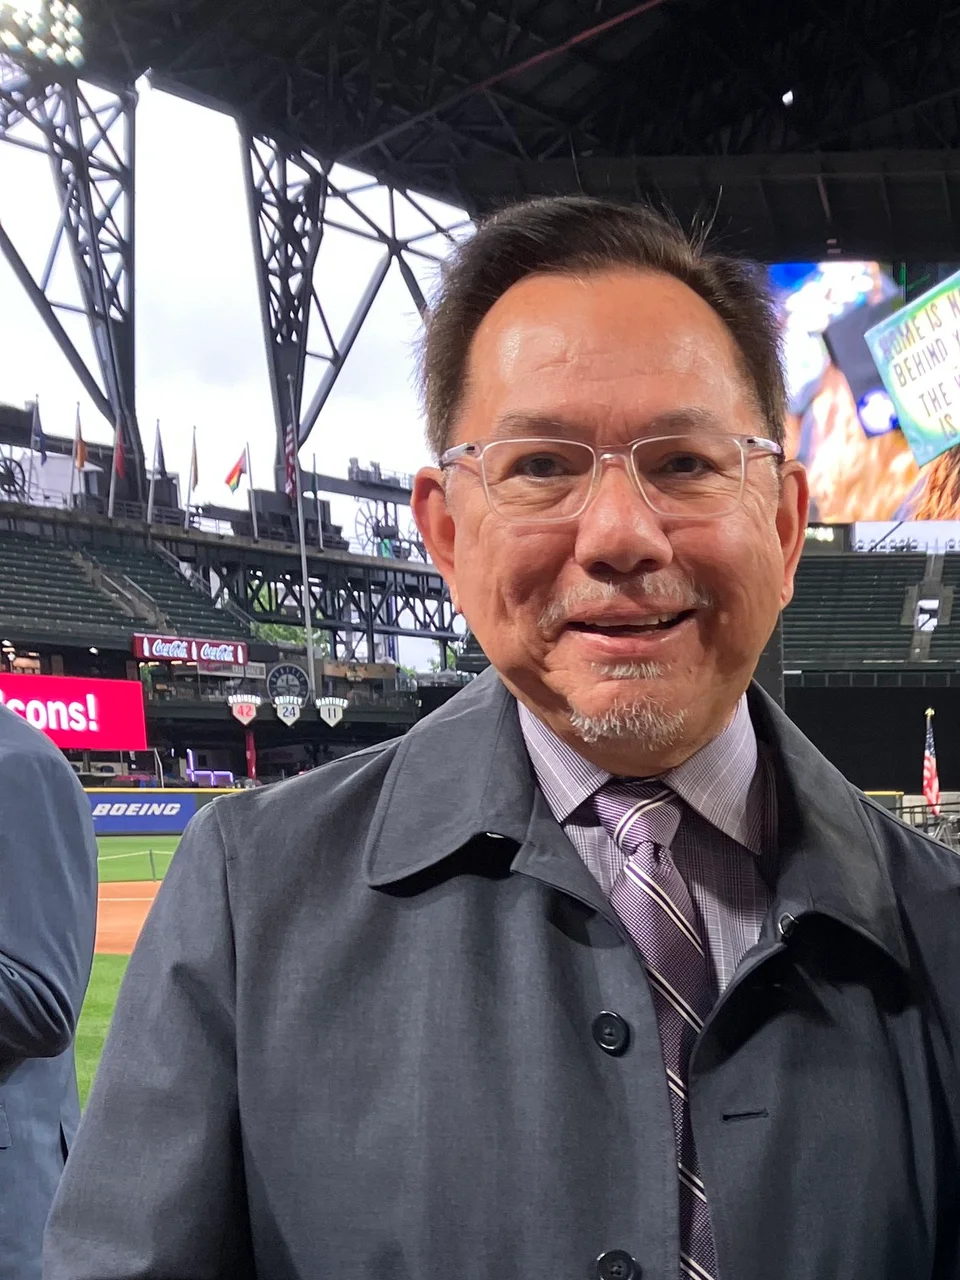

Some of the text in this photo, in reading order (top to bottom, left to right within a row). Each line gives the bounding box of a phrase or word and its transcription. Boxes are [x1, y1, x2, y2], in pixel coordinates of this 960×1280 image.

[924, 303, 943, 332] IS
[893, 338, 948, 388] BEHIND
[918, 382, 952, 417] THE
[938, 413, 958, 441] IS
[152, 639, 188, 659] Coca-Cola
[200, 643, 235, 662] Coca-Cola
[237, 706, 253, 717] 42
[282, 706, 296, 718] 24
[327, 707, 337, 719] 11
[92, 803, 181, 816] BOEING
